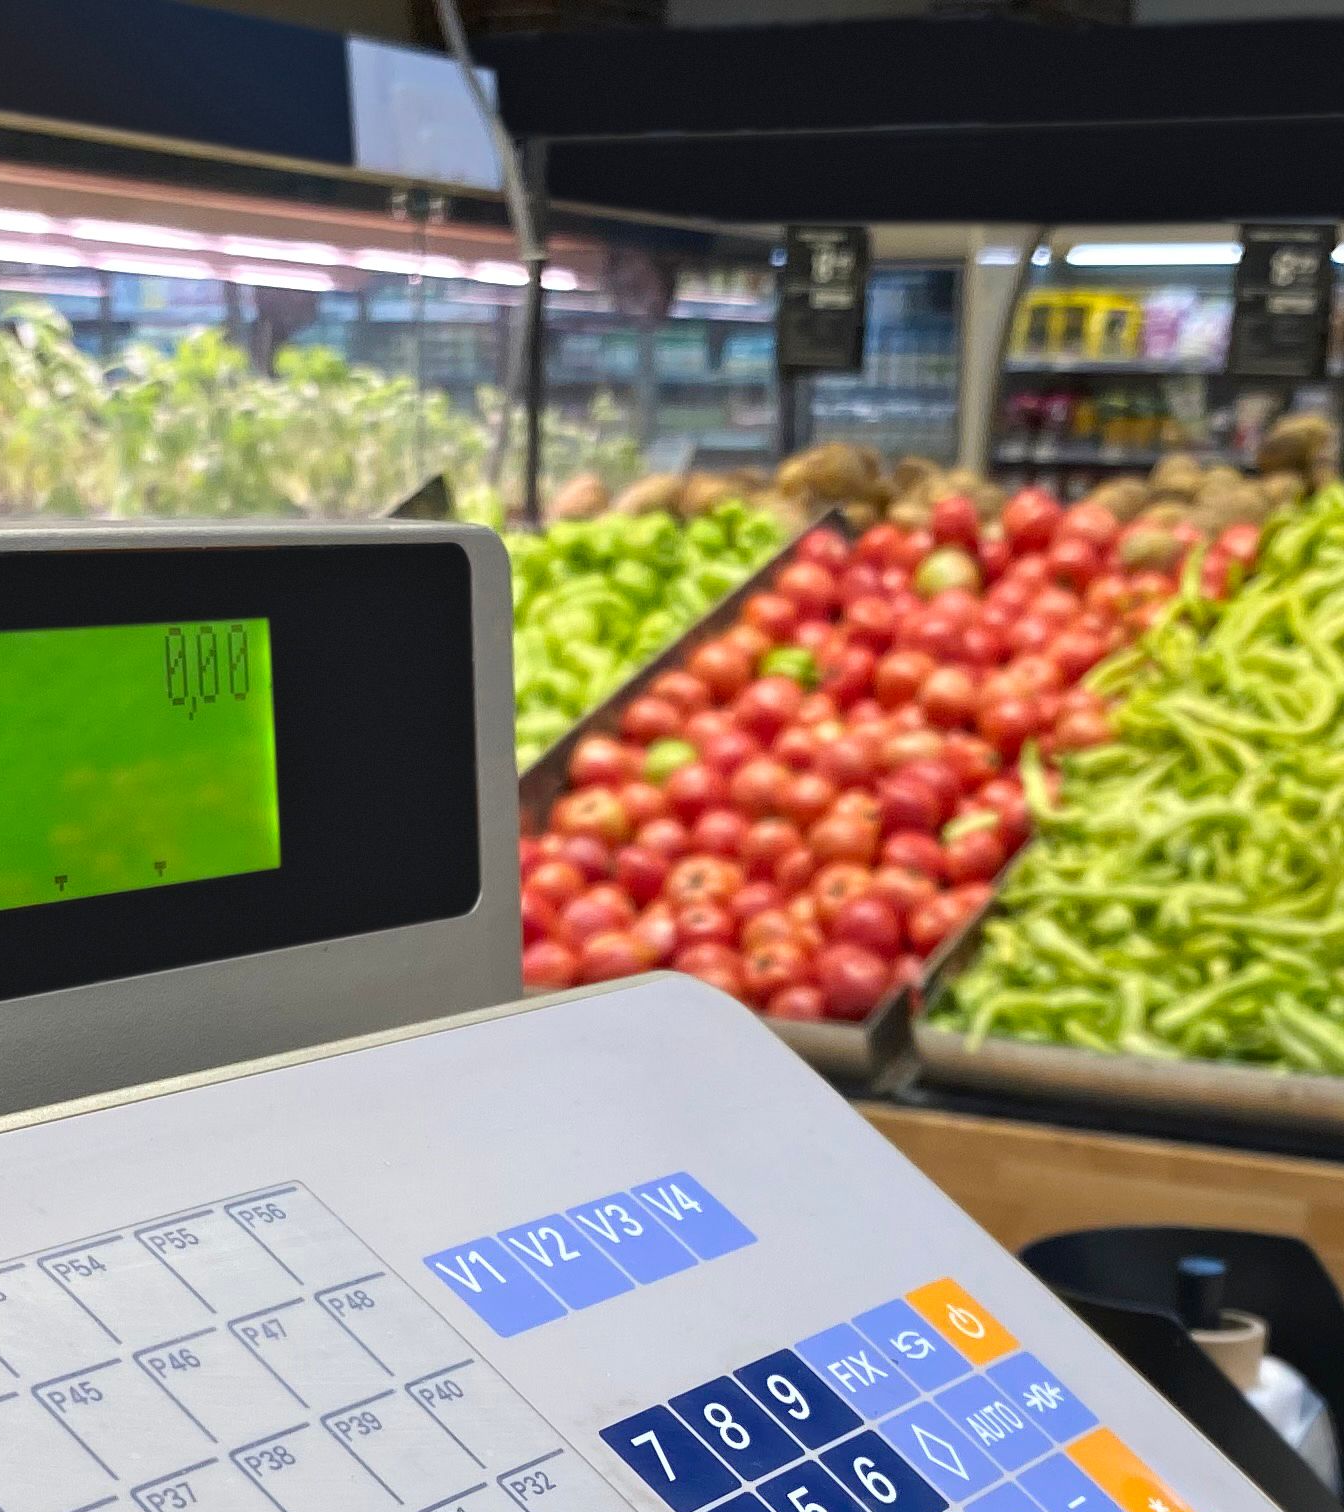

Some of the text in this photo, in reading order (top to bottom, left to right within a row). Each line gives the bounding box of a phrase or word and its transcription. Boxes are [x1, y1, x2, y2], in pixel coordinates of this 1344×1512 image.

[165, 624, 249, 720] 0,00
[55, 1255, 106, 1282] P54
[150, 1228, 199, 1254] P55
[239, 1203, 286, 1228] P56
[435, 1184, 702, 1293] V1 V2 V3 V4
[48, 1383, 103, 1413] P45
[149, 1349, 200, 1379] P46
[243, 1320, 288, 1346] P47
[329, 1290, 375, 1317] P48
[244, 1445, 296, 1476] P38
[335, 1412, 383, 1442] P39
[418, 1380, 464, 1408] P40
[631, 1351, 888, 1482] 7 8 9 FIX
[854, 1456, 897, 1504] 6
[966, 1401, 1024, 1447] AUTO
[510, 1471, 557, 1501] P32
